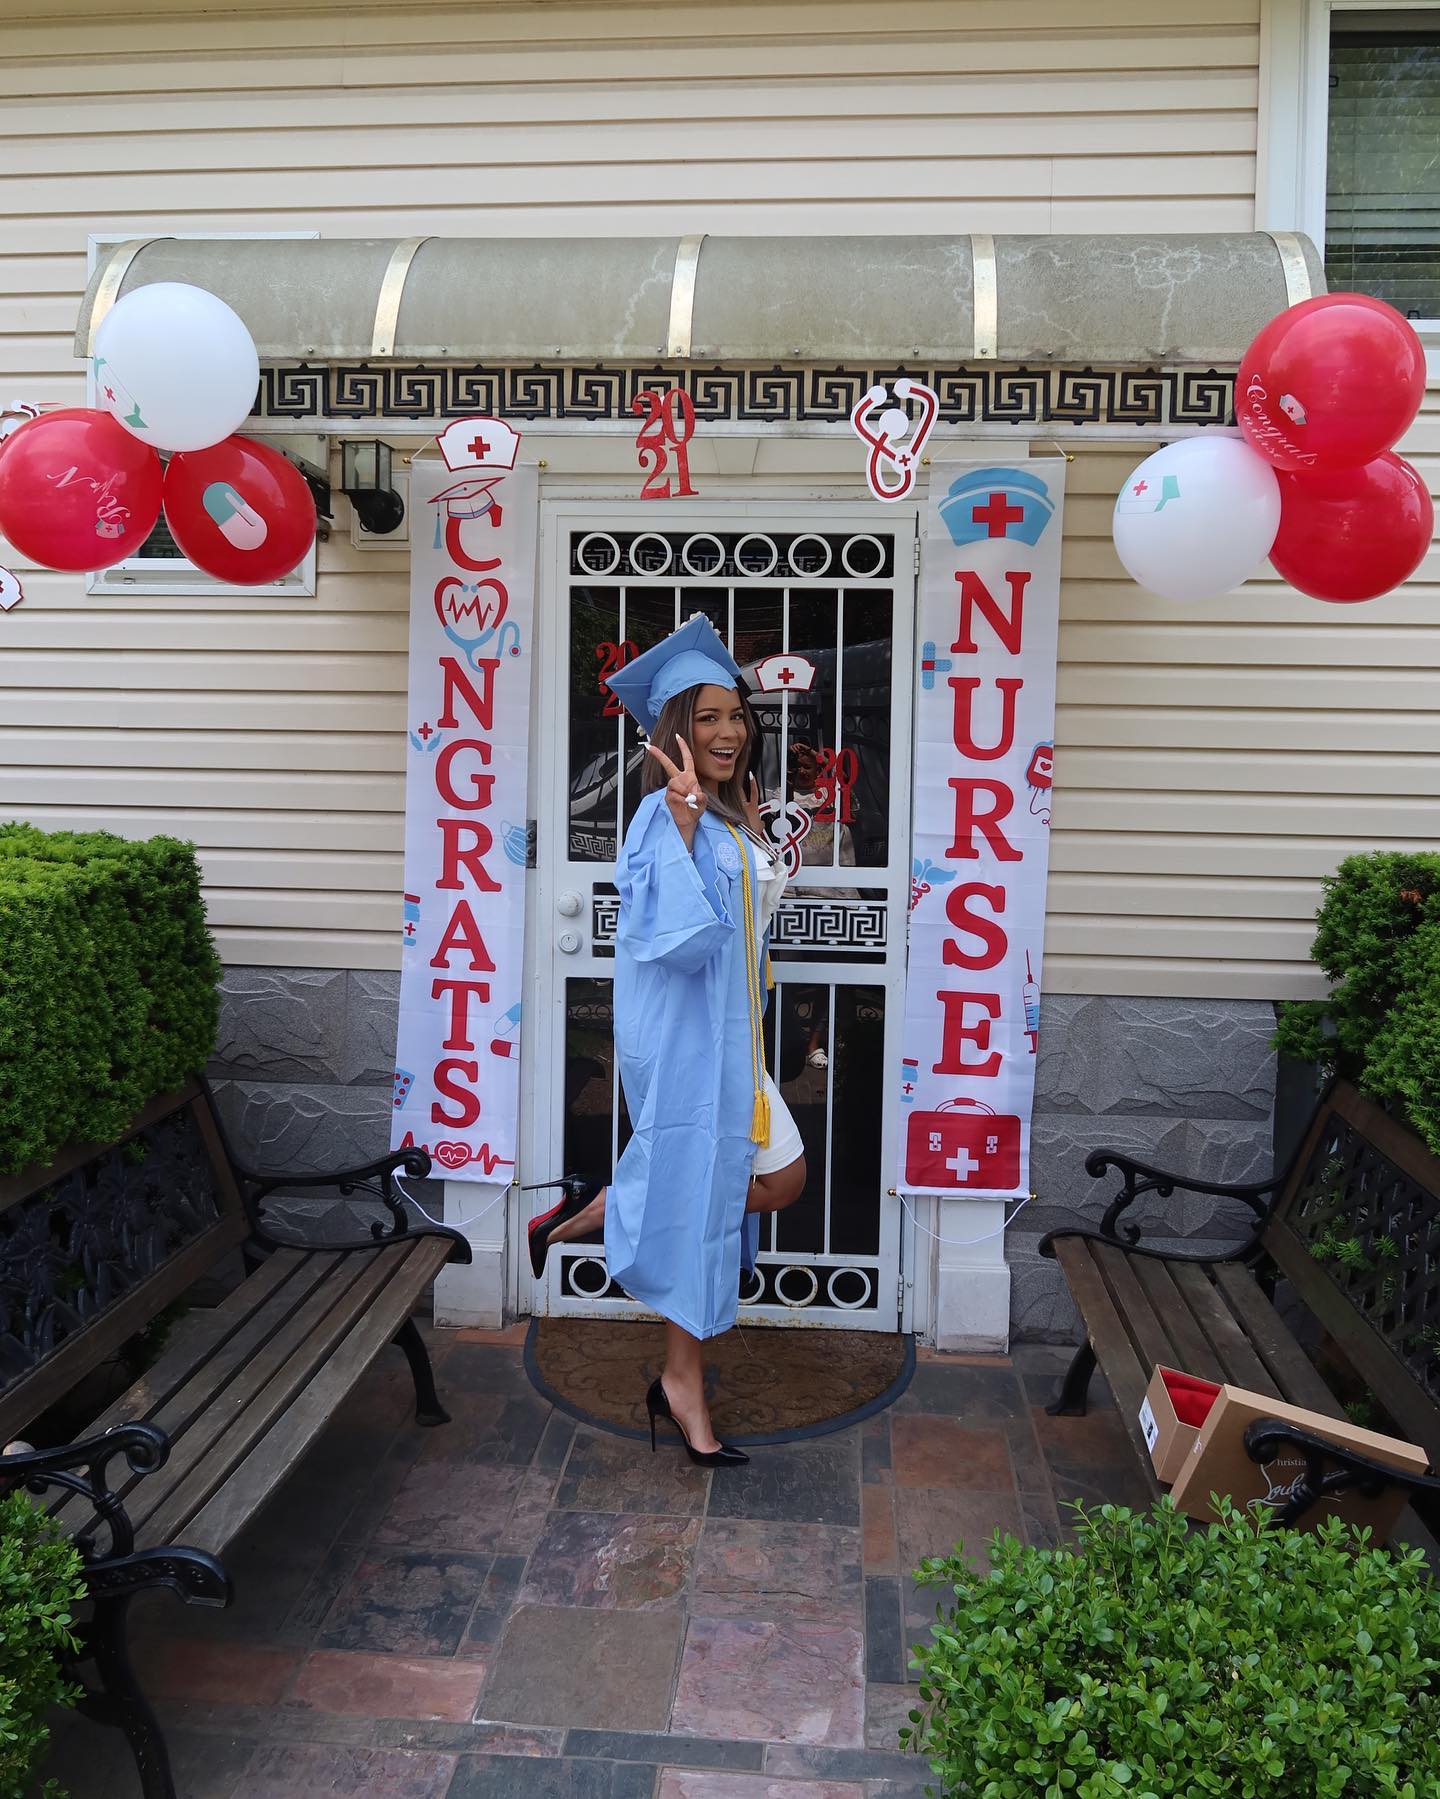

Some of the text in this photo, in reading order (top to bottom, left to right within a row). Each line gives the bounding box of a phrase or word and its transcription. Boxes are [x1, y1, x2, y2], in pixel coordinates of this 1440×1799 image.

[631, 388, 696, 447] 20
[1246, 374, 1318, 466] Congrats
[638, 446, 700, 500] 21
[815, 747, 858, 785] 20
[814, 783, 857, 823] 21
[931, 571, 1032, 1078] NURSE
